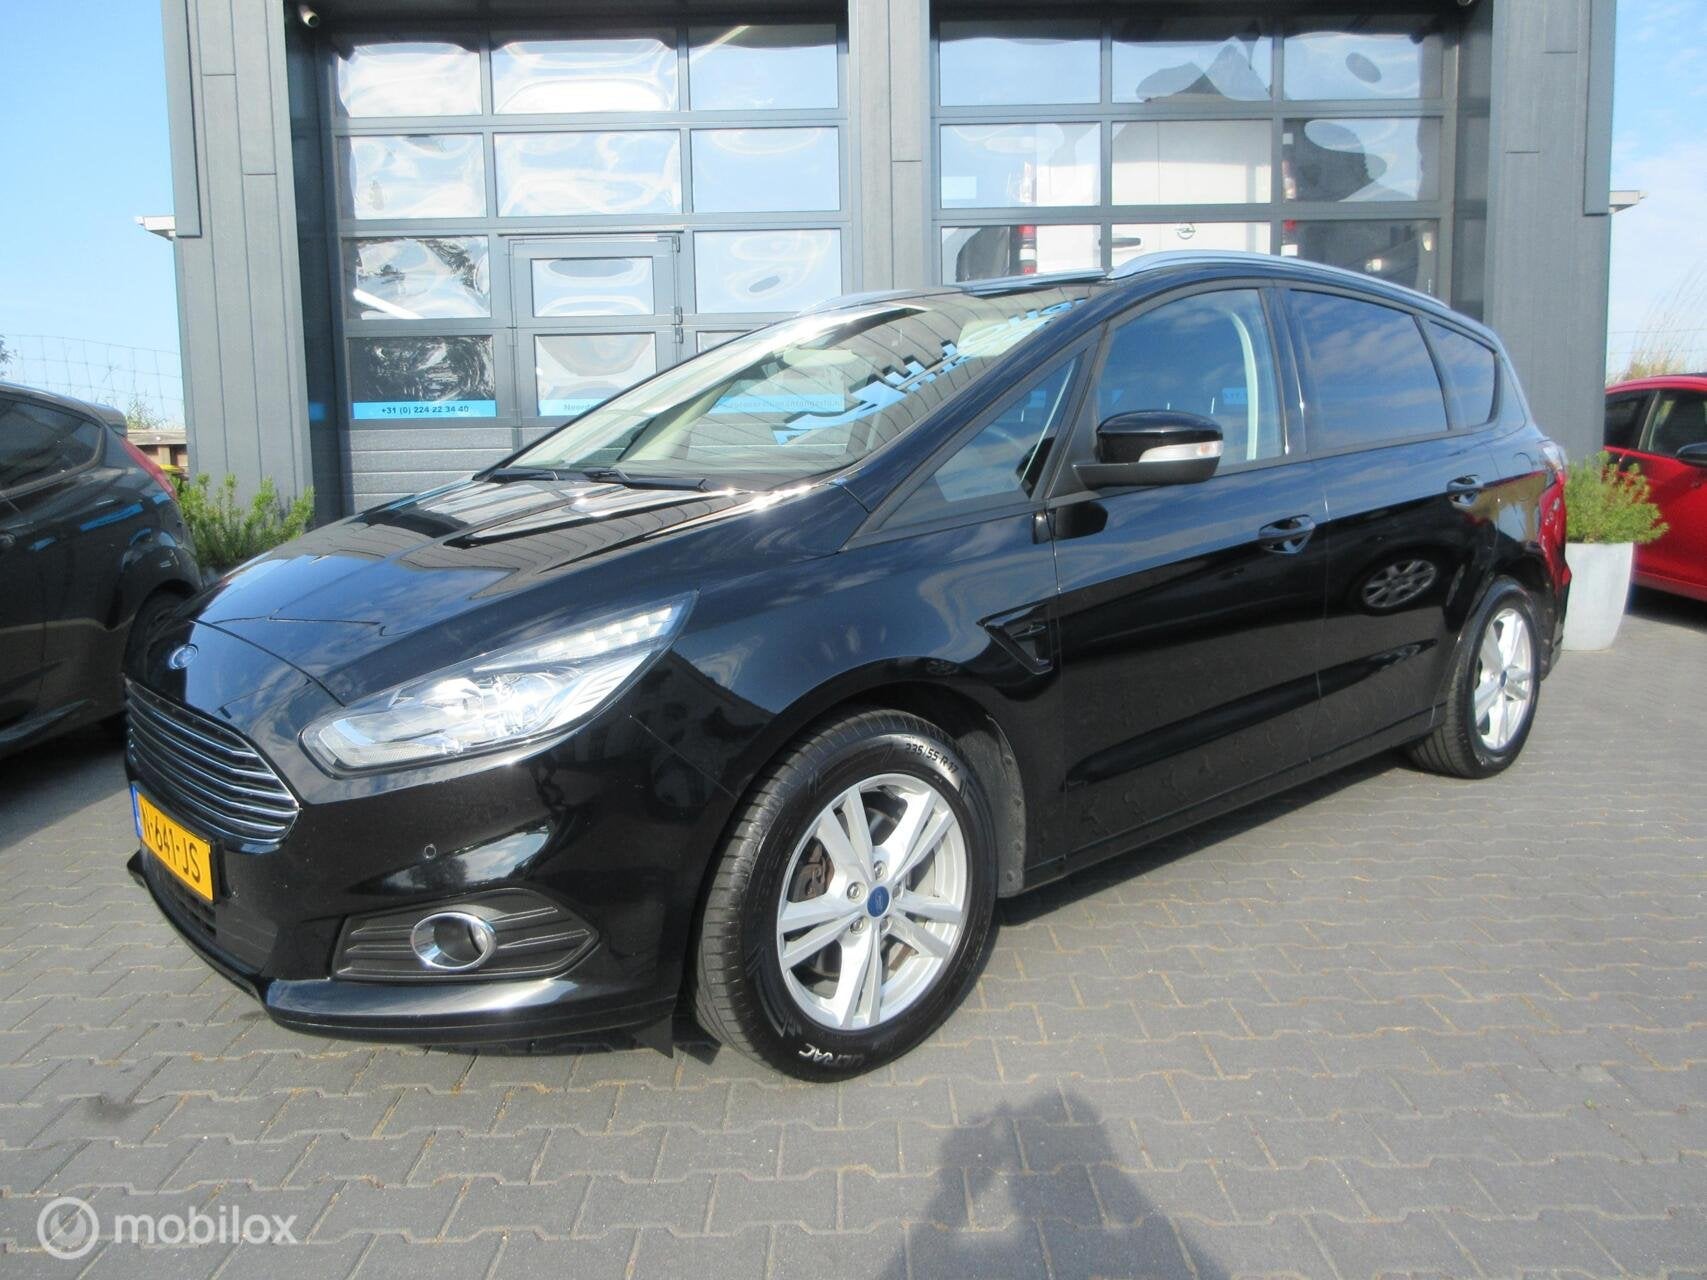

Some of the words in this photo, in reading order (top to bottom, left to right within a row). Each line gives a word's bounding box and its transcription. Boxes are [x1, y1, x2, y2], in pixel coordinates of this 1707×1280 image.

[381, 407, 397, 415] +31
[399, 407, 411, 415] (0)
[413, 406, 429, 414] 224
[445, 405, 456, 413] 34
[458, 405, 469, 413] 40
